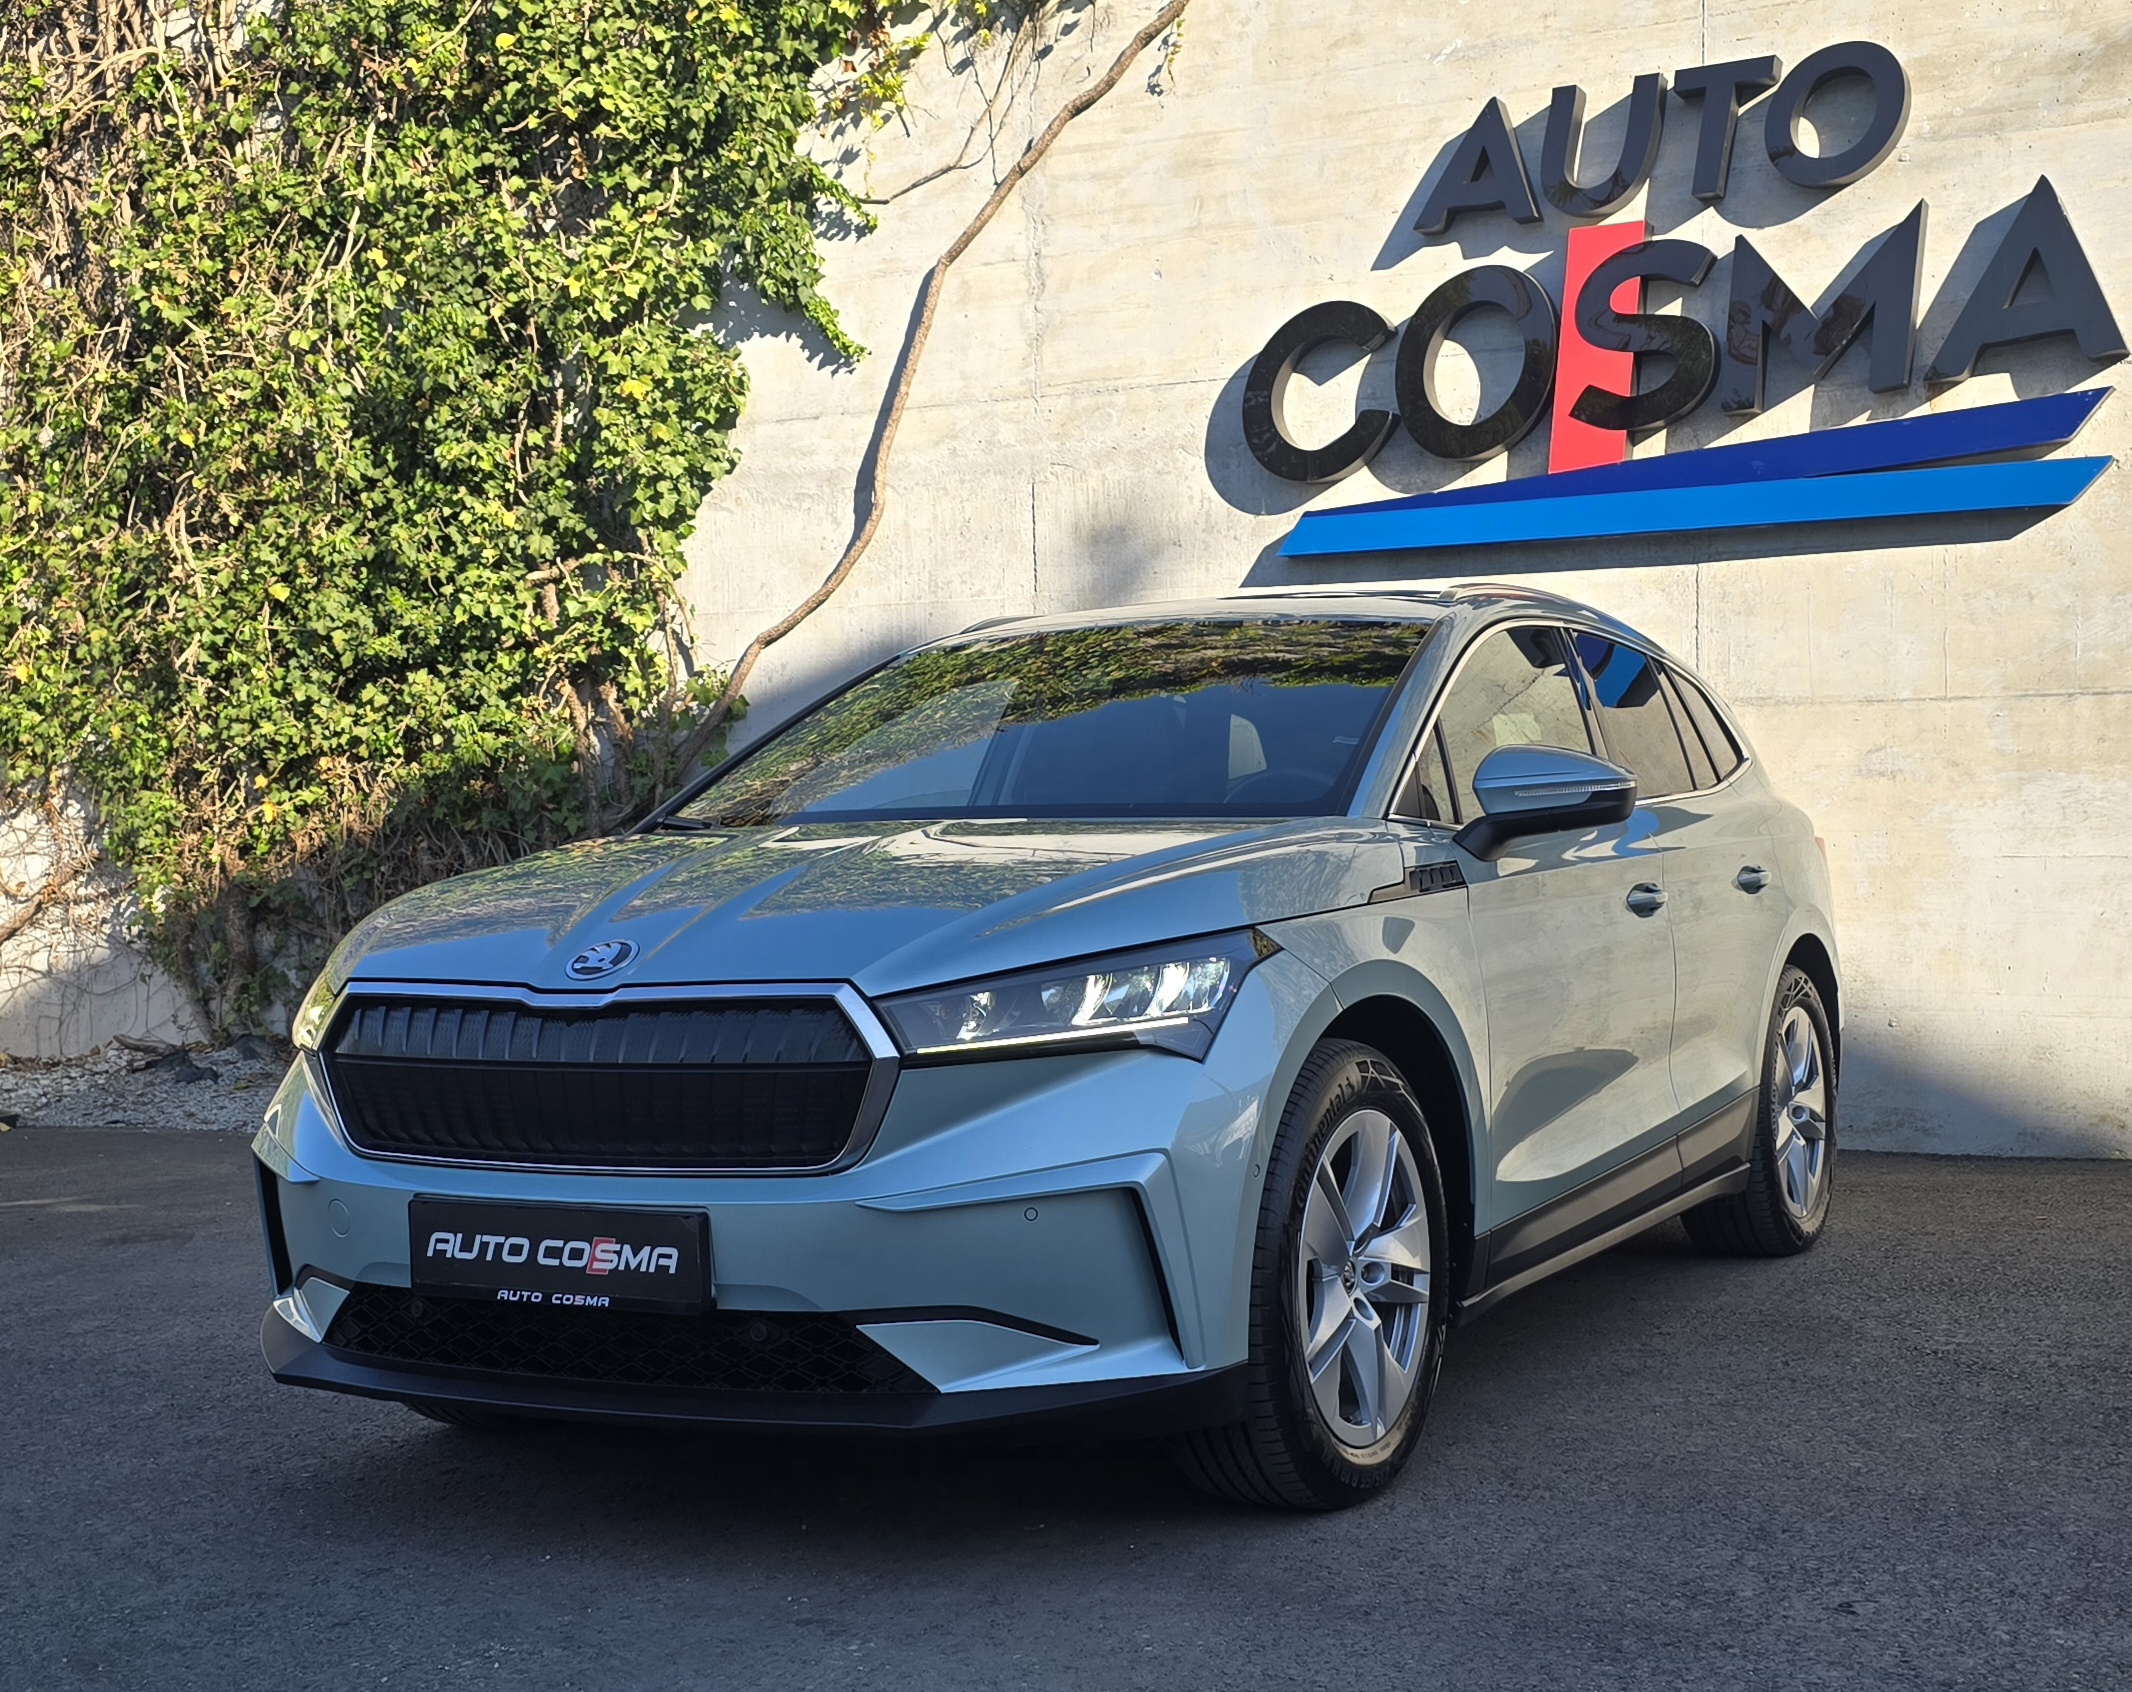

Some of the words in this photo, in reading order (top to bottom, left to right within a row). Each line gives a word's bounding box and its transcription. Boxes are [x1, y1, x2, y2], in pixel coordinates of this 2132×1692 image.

[1412, 41, 1912, 234] AUTO
[1241, 174, 2130, 482] COSMA
[426, 1231, 530, 1263] AUTO
[536, 1239, 679, 1274] COSMA
[496, 1290, 543, 1303] AUTO
[551, 1293, 610, 1307] COSMA
